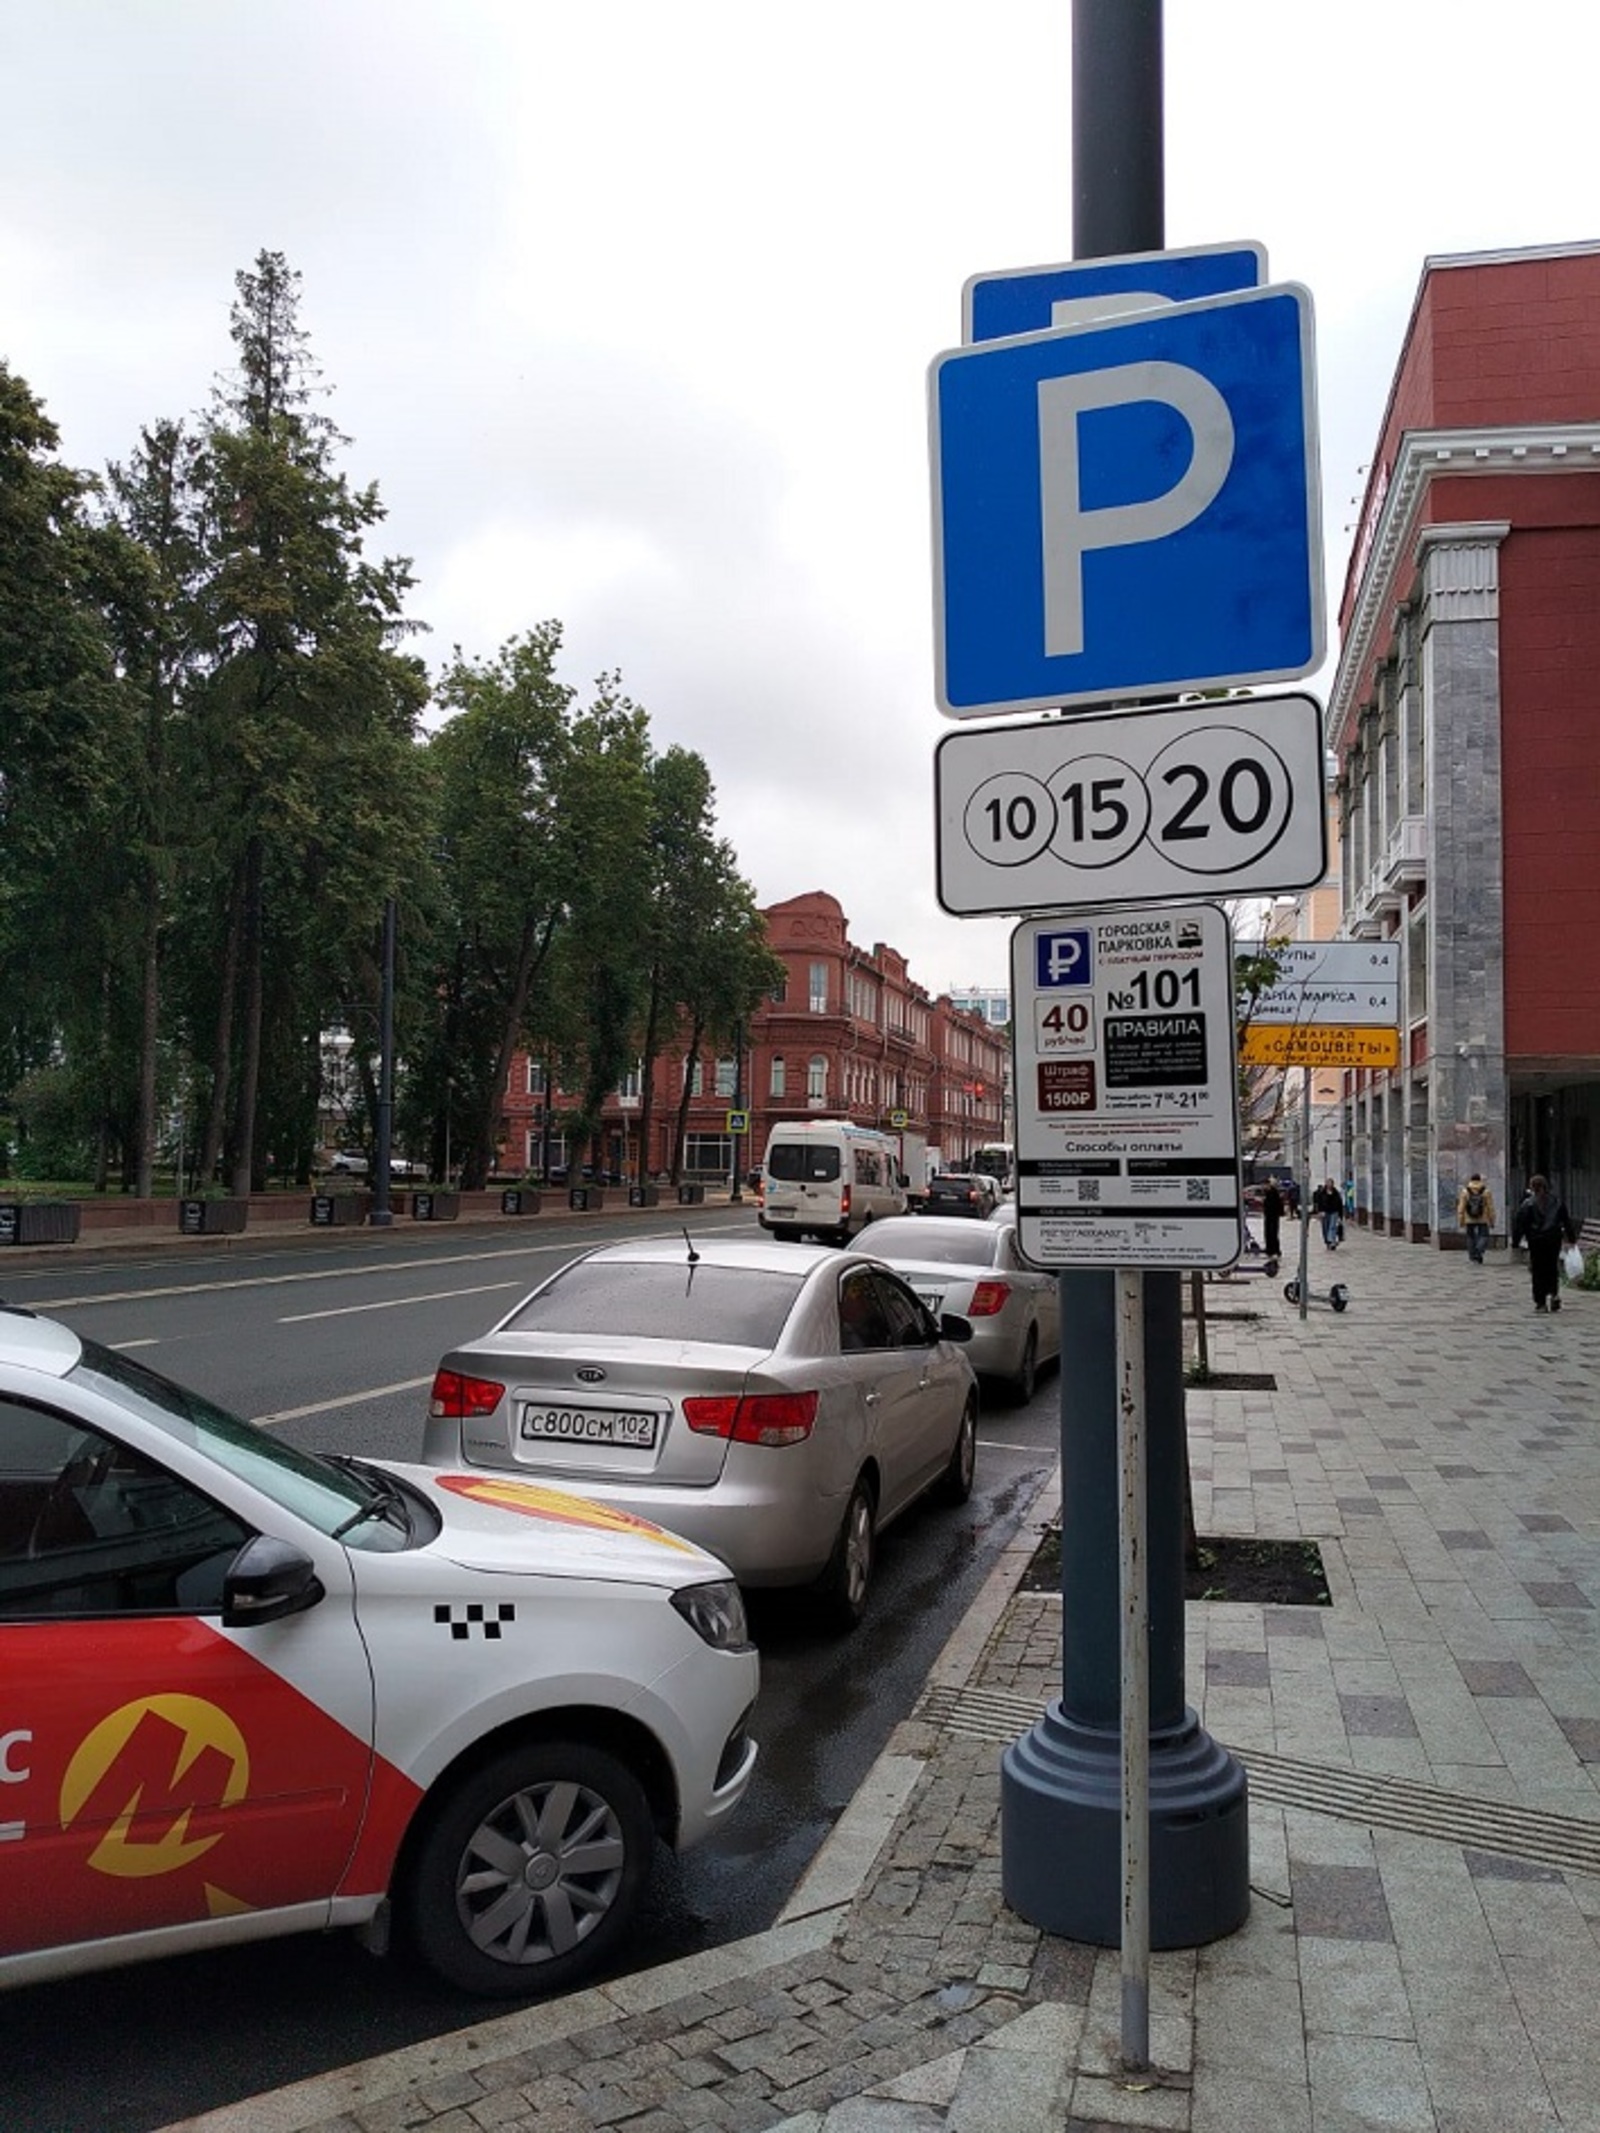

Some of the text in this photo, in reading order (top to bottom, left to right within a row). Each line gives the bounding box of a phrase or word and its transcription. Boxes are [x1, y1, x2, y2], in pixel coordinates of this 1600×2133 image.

[1038, 360, 1236, 658] P
[985, 758, 1272, 842] 10 15 20
[1098, 921, 1171, 937] ГОРОДСКАЯ
[1098, 937, 1174, 953] ПАРКОВКА
[1107, 967, 1200, 1011] №101
[1258, 991, 1357, 1002] АРЛА МАРКСА
[1042, 1003, 1088, 1032] 40
[1107, 1019, 1201, 1038] ПРАВИЛА
[1044, 1064, 1089, 1077] Штраф
[1065, 1141, 1183, 1153] Способы оплаты
